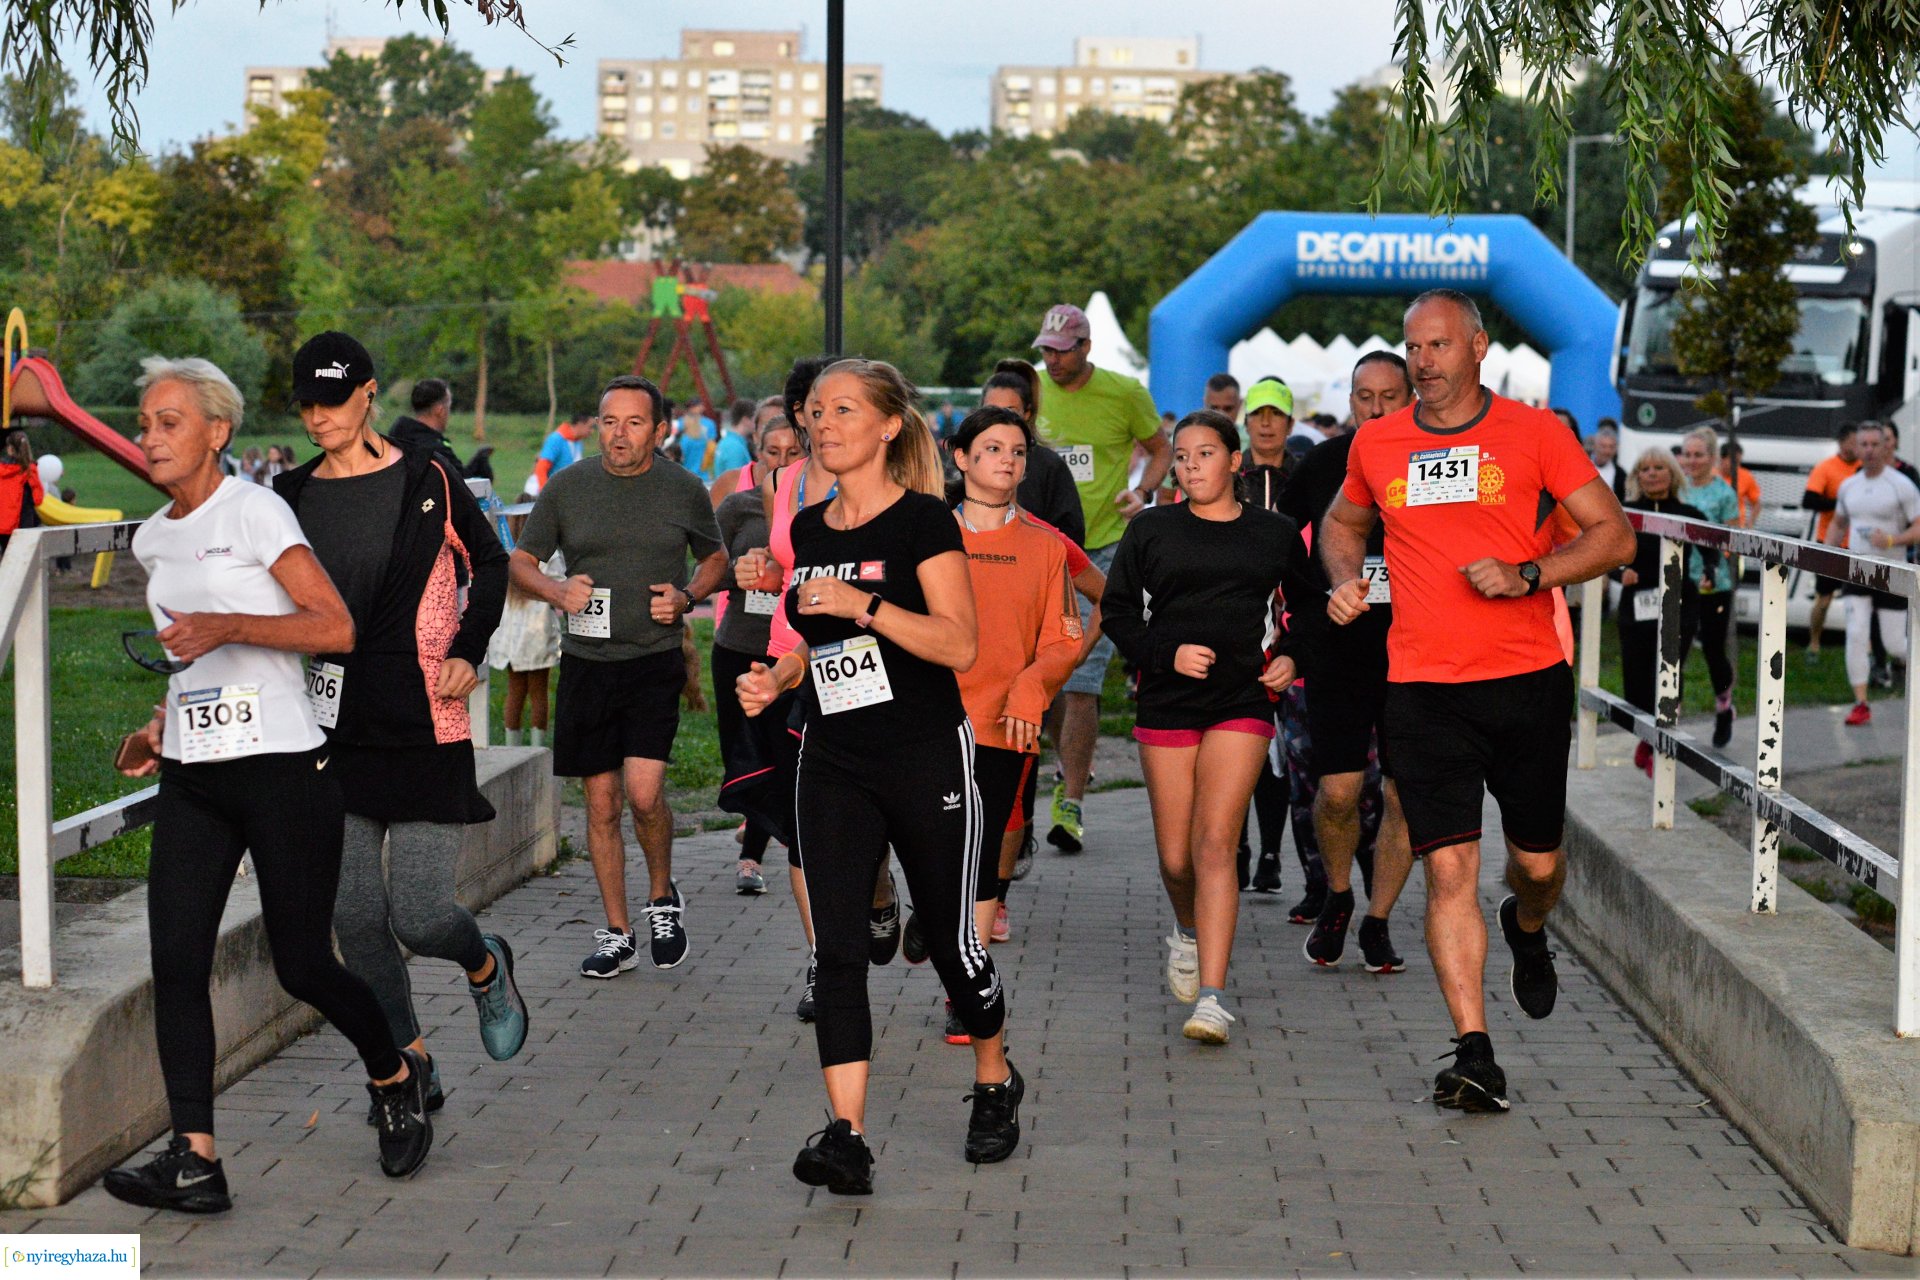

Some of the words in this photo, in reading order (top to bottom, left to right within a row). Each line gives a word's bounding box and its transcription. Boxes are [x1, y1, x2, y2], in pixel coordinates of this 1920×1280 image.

[1297, 232, 1488, 263] DECATHLON
[1046, 313, 1069, 332] W
[1418, 459, 1469, 481] 1431
[790, 566, 810, 586] ST
[837, 562, 858, 581] IT.
[1361, 567, 1389, 582] 73
[578, 600, 604, 615] 23
[815, 650, 878, 684] 1604
[184, 700, 252, 731] 1308
